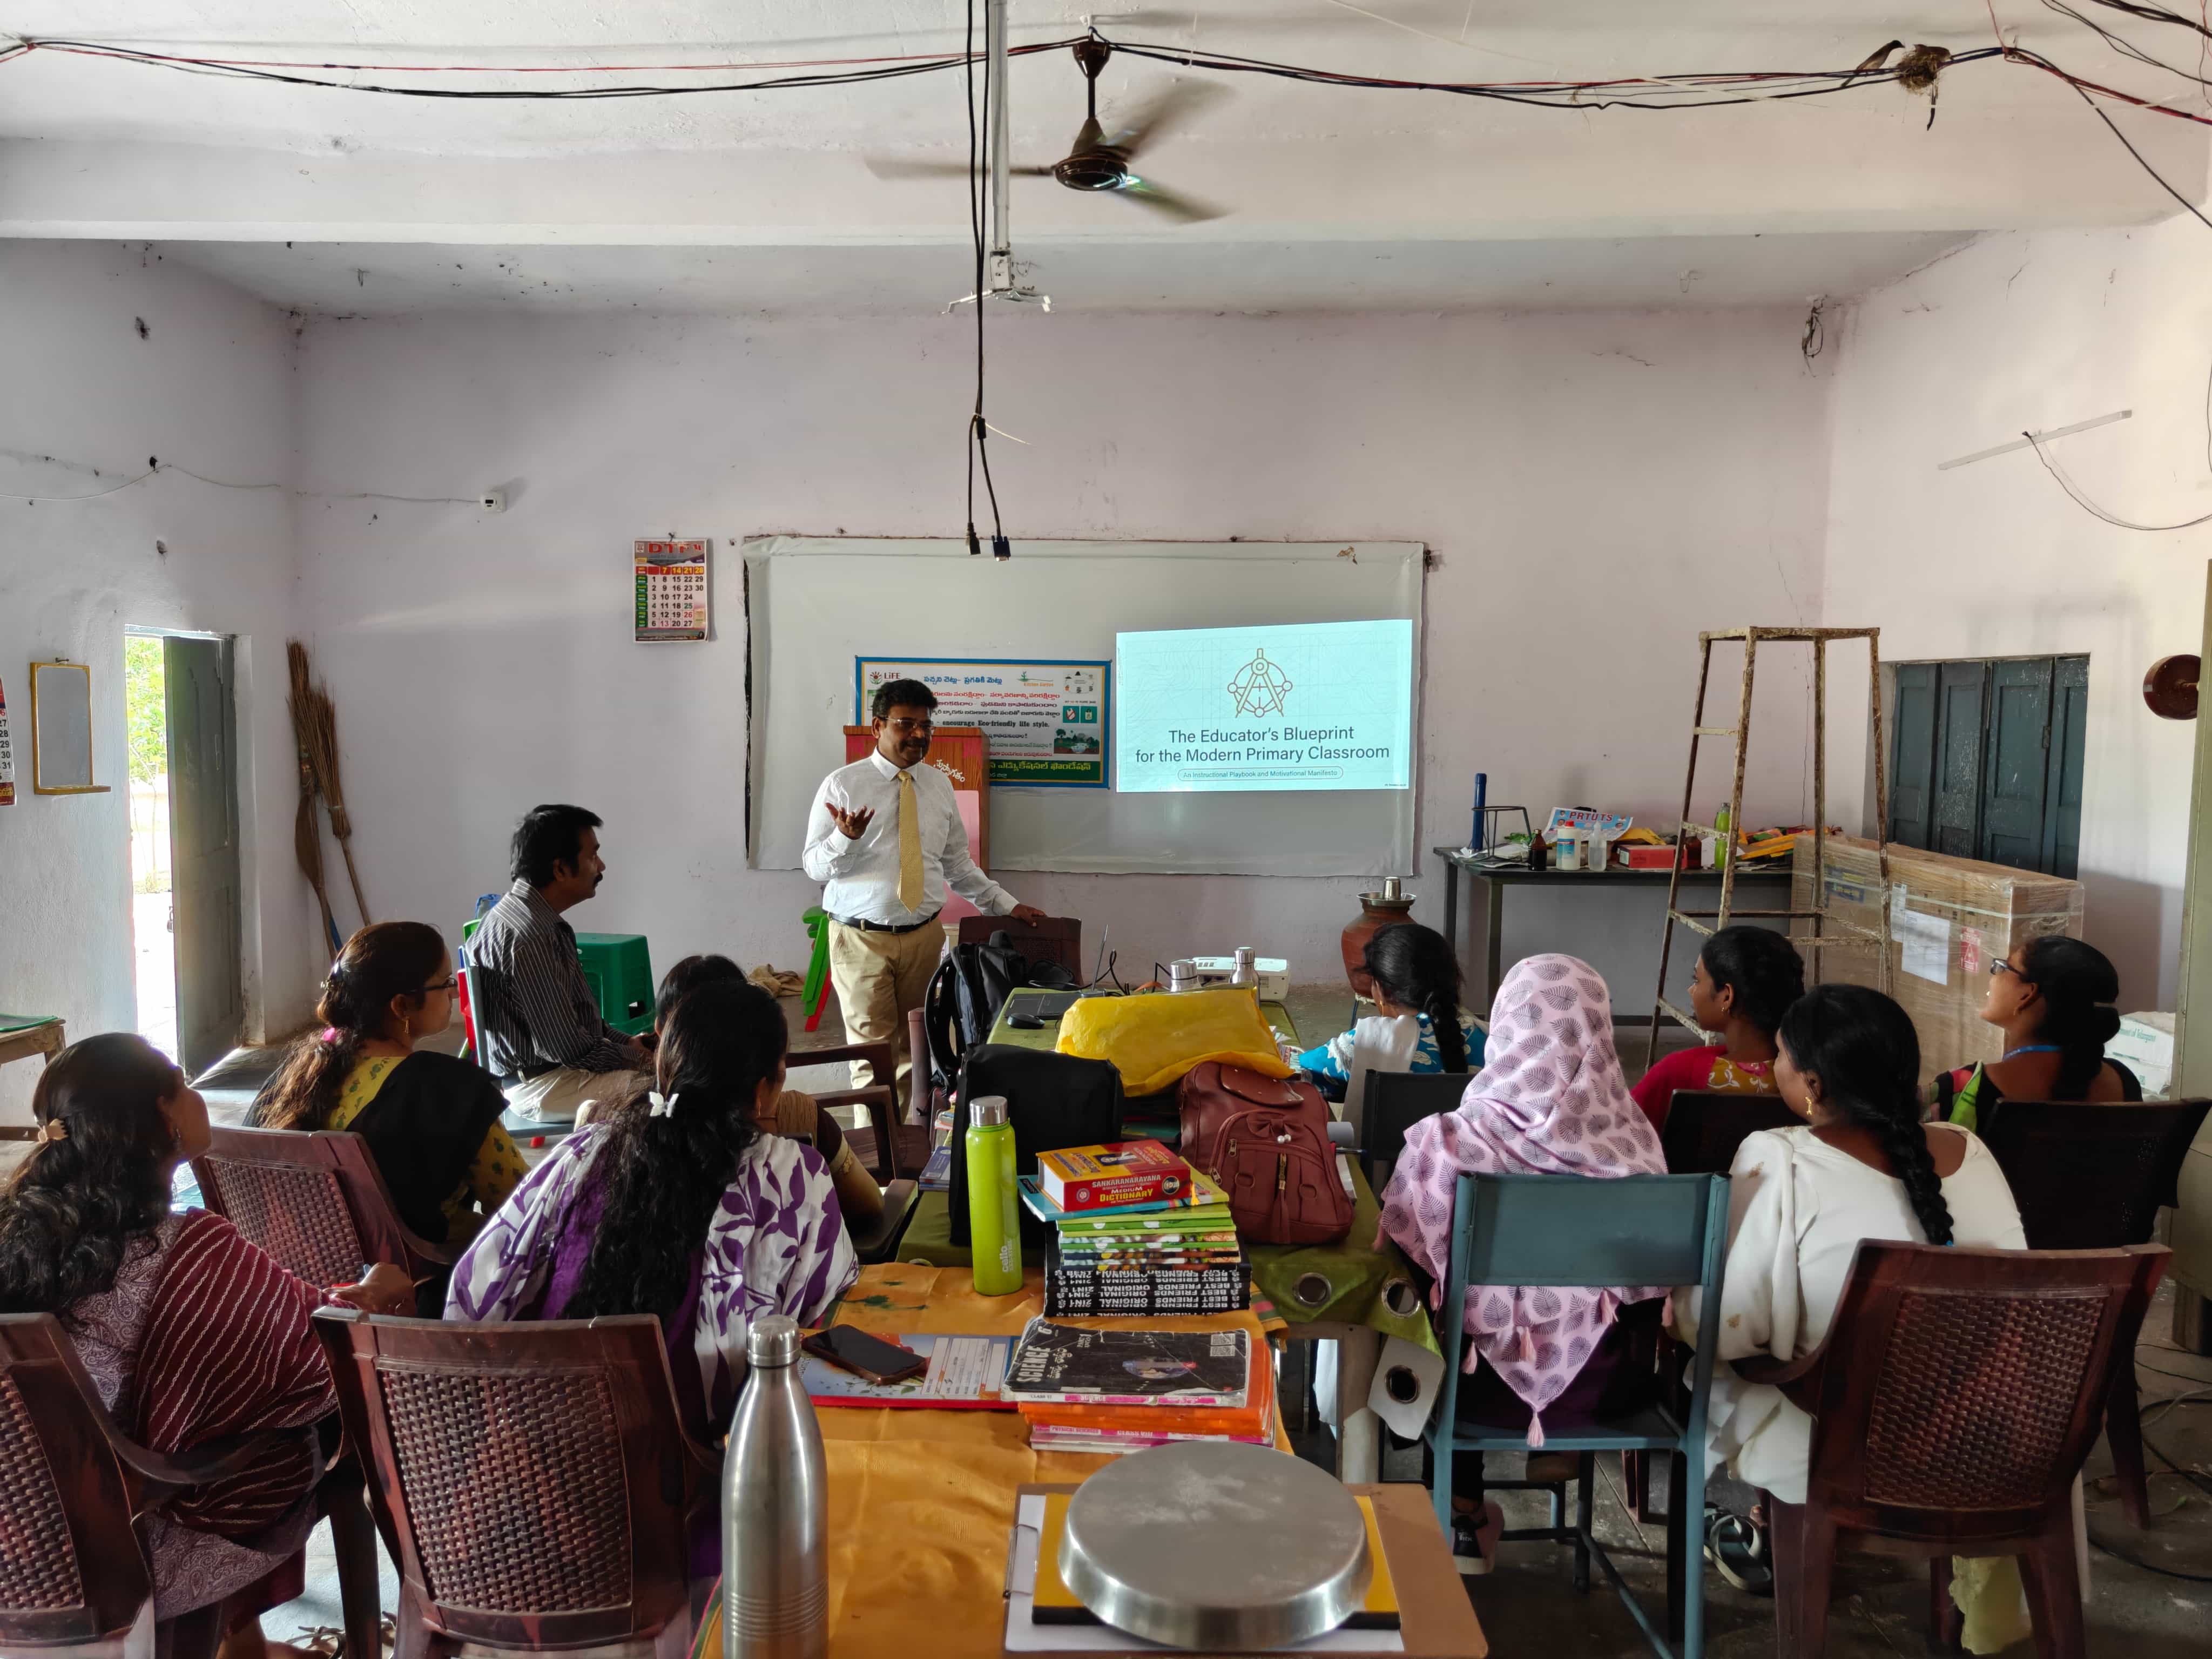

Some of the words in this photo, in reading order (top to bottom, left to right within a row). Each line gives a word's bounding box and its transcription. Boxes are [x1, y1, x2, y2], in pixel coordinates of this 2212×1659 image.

[978, 720, 1016, 729] Eco-friendly
[1169, 730, 1196, 743] The
[1284, 726, 1354, 744] Blueprint
[1136, 749, 1155, 762] for
[1158, 748, 1182, 761] the
[1186, 748, 1241, 761] Modern
[1246, 747, 1303, 763] Primary
[1308, 745, 1390, 759] Classroom
[2, 761, 11, 770] 31
[1091, 1175, 1161, 1188] SANKARANARAYANA
[1111, 1186, 1143, 1194] MEDIUM
[1016, 1345, 1051, 1382] SCIENCE
[1037, 1326, 1053, 1335] 6
